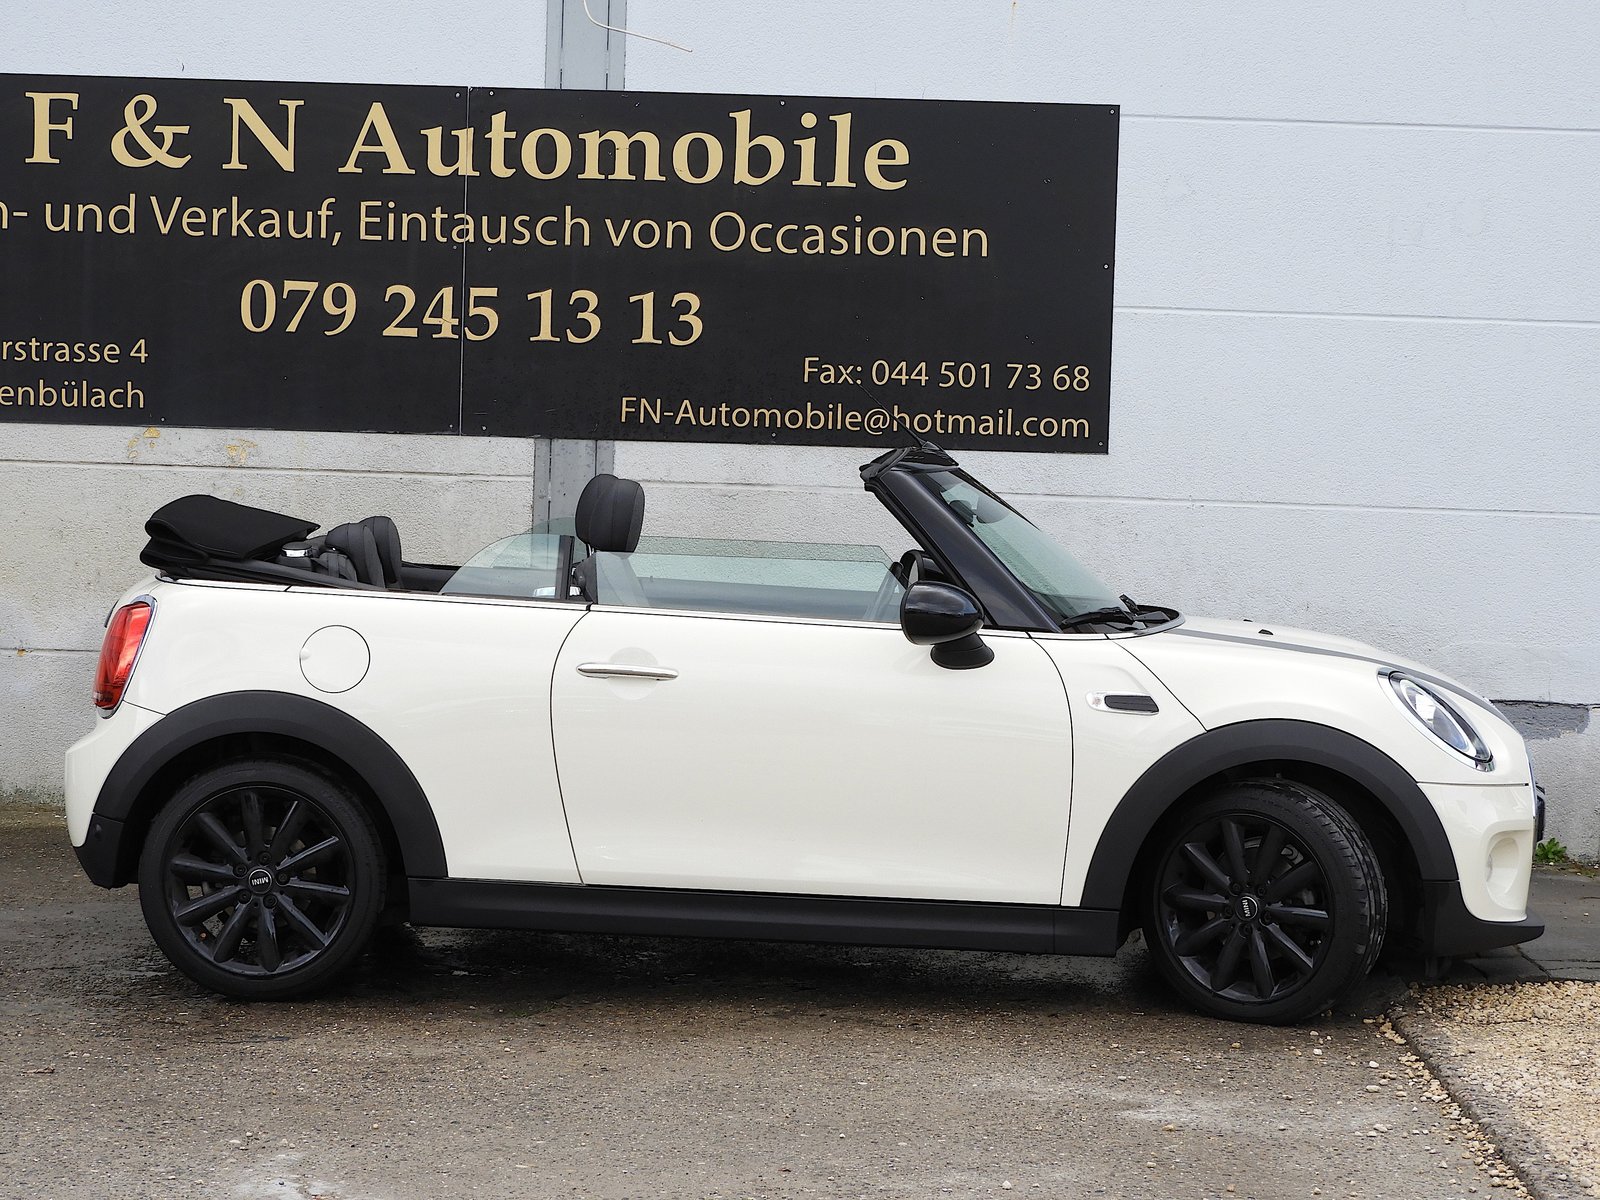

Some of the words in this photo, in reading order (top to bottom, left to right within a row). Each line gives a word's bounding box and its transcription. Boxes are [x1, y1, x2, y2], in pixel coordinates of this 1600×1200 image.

[25, 91, 80, 164] F
[110, 93, 192, 169] &
[222, 97, 305, 172] N
[338, 102, 910, 191] Automobile
[45, 193, 136, 234] und
[150, 195, 341, 246] Verkauf,
[359, 200, 590, 246] Eintausch
[605, 218, 692, 249] von
[709, 211, 988, 257] Occasionen
[240, 279, 357, 336] 079
[382, 284, 499, 341] 245
[526, 288, 601, 344] 13
[628, 291, 703, 346] 13
[2, 337, 120, 363] rstrasse
[129, 338, 148, 363] 4
[0, 379, 144, 409] enbülach
[803, 357, 862, 385] Fax:
[871, 359, 928, 386] 044
[939, 361, 990, 388] 501
[1006, 363, 1042, 390] 73
[1053, 365, 1089, 392] 68
[620, 397, 1089, 438] FN-Automobile@hotmail.com
